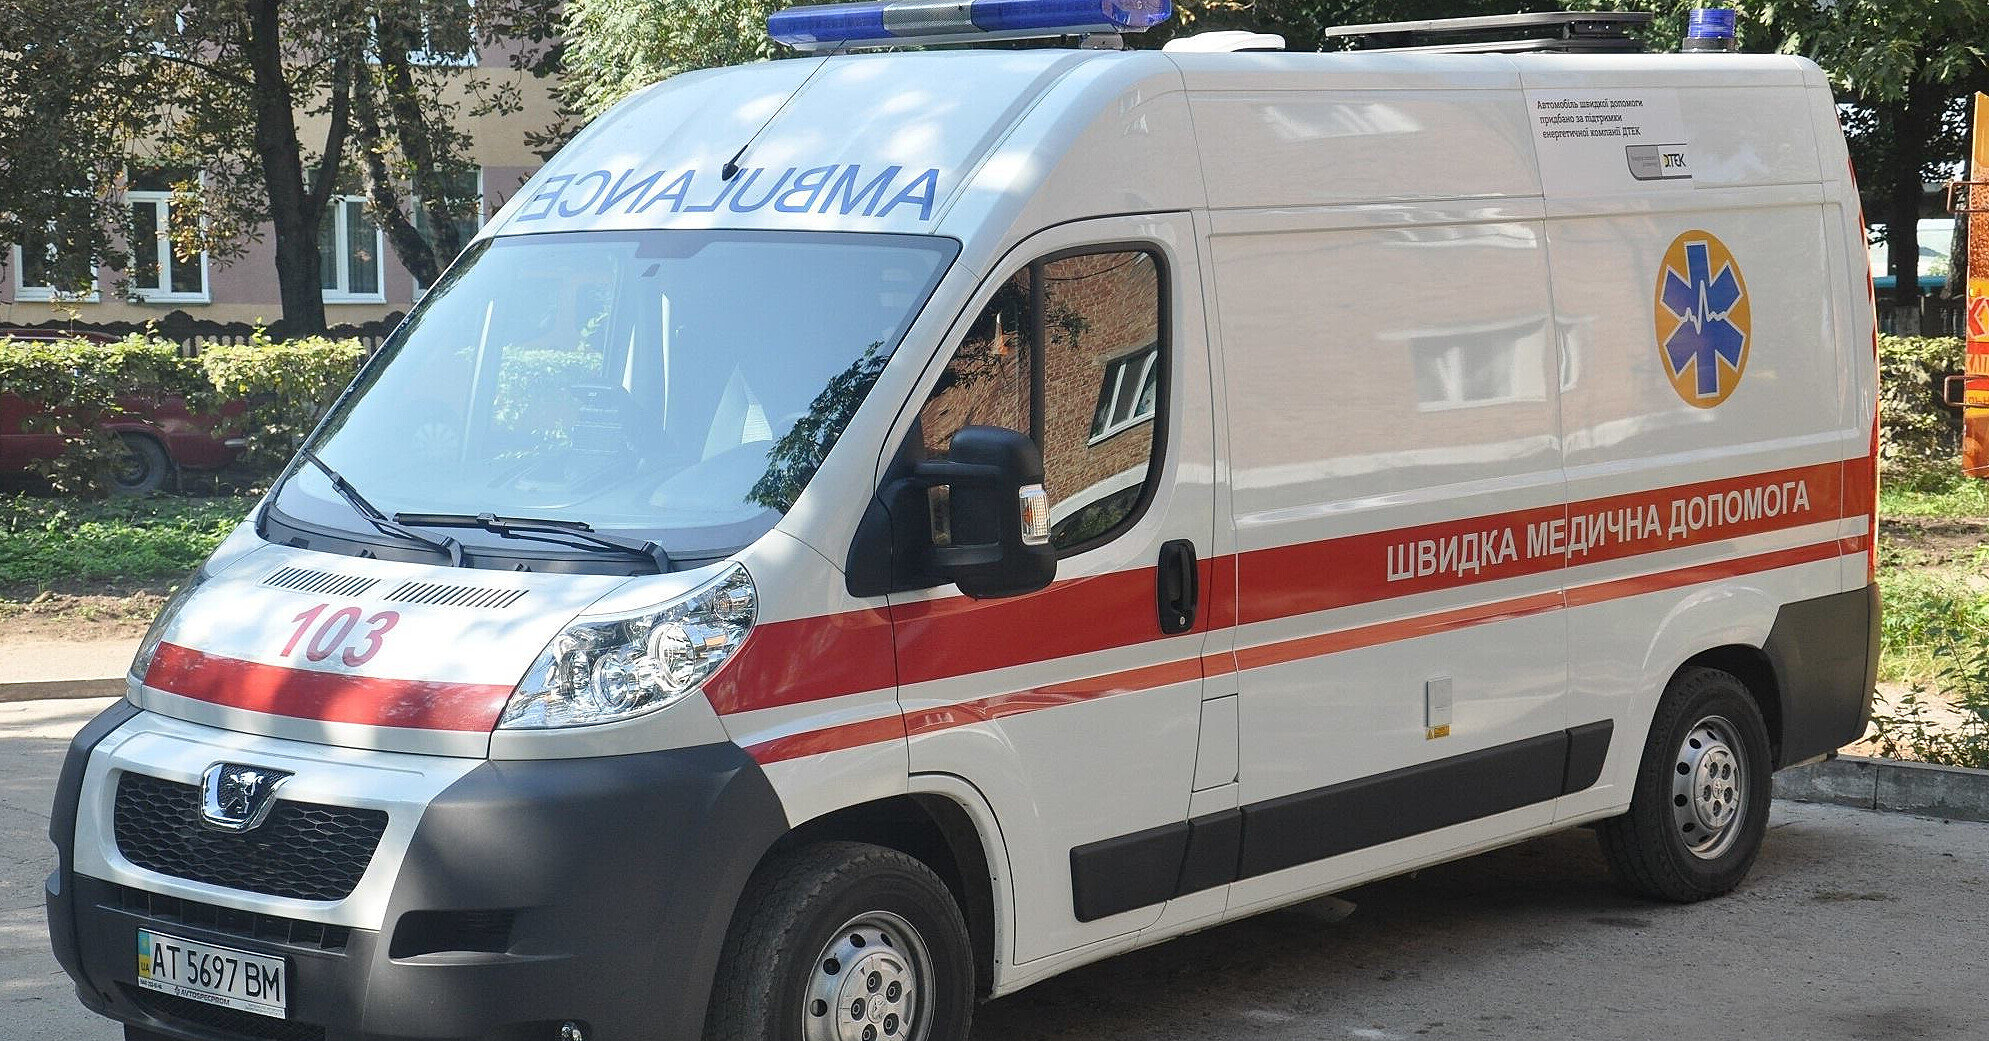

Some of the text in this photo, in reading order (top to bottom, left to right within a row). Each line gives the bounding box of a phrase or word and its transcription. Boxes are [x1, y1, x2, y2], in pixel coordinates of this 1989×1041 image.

[1537, 98, 1643, 109] Автомобіль швидкої допомоги
[1540, 113, 1622, 126] придбано за підтримки
[1543, 127, 1641, 141] енергетичної компанії ДТЕК
[1386, 480, 1811, 583] ШВИДКА МЕДИЧНА ДОПОМОГА
[279, 603, 400, 668] 103
[140, 962, 150, 972] UA
[152, 942, 280, 1002] AT 5697 BM
